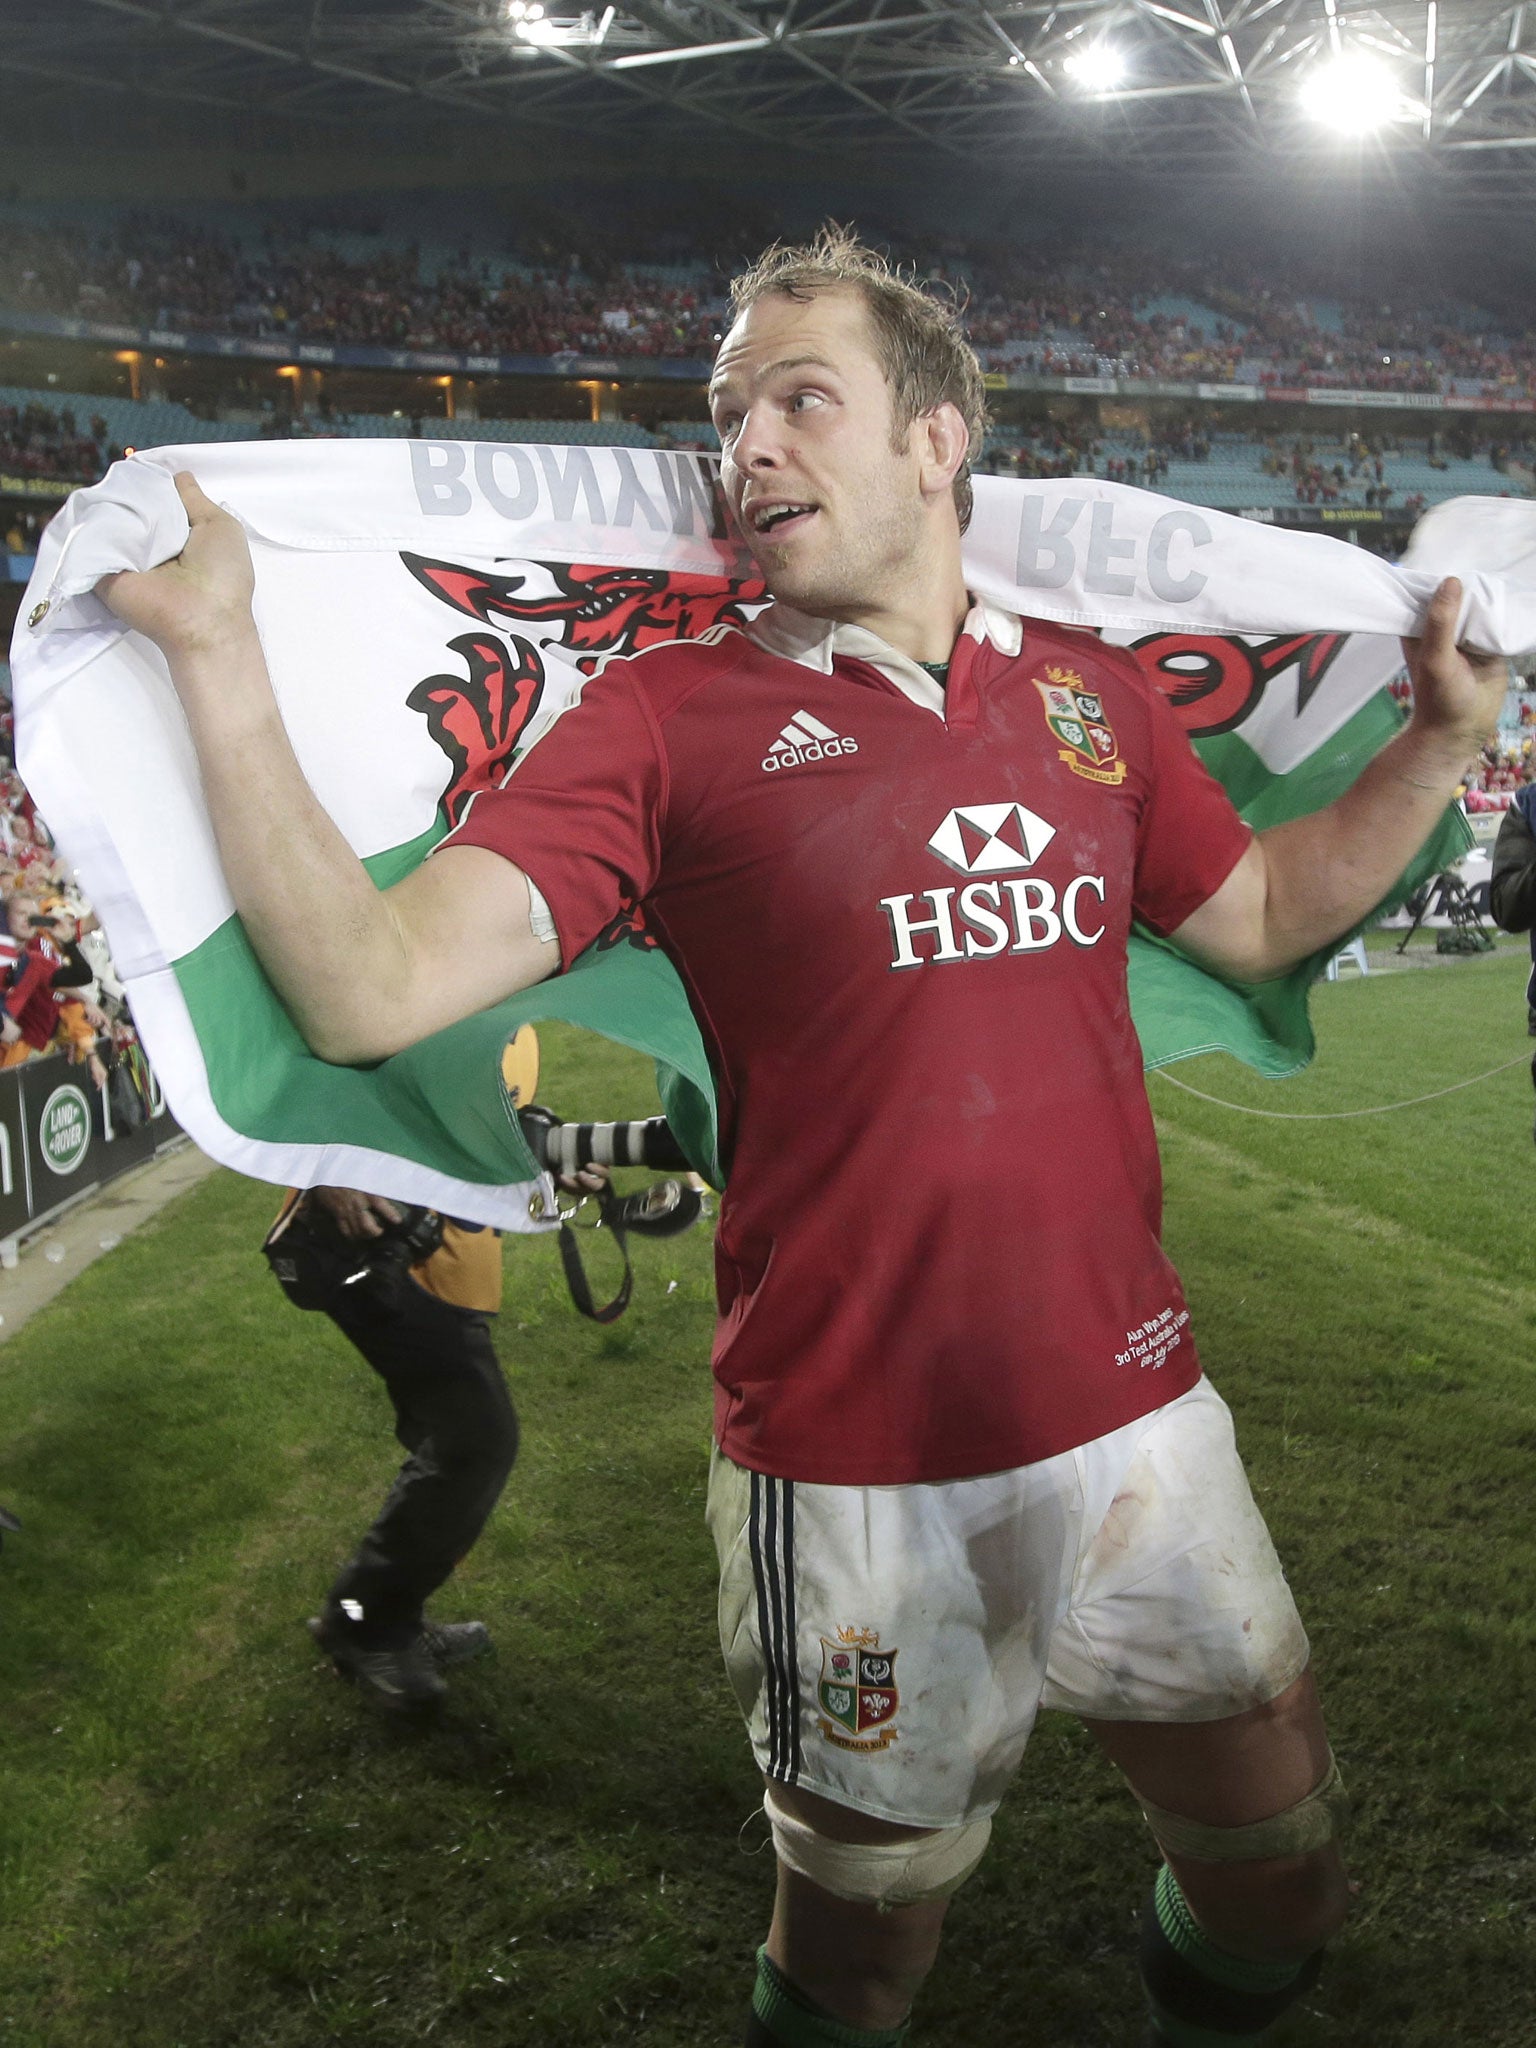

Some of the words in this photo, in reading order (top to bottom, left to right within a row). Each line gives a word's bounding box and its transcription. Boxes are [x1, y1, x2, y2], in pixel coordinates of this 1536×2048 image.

[466, 357, 499, 371] NEW
[761, 736, 859, 772] adidas
[878, 874, 1106, 970] HSBC
[50, 1103, 74, 1133] LAND
[53, 1122, 83, 1155] ROVER
[1126, 1328, 1146, 1345] Alun
[1141, 1319, 1161, 1334] Wyn
[1114, 1350, 1131, 1366] 3rd
[1128, 1341, 1149, 1359] Test
